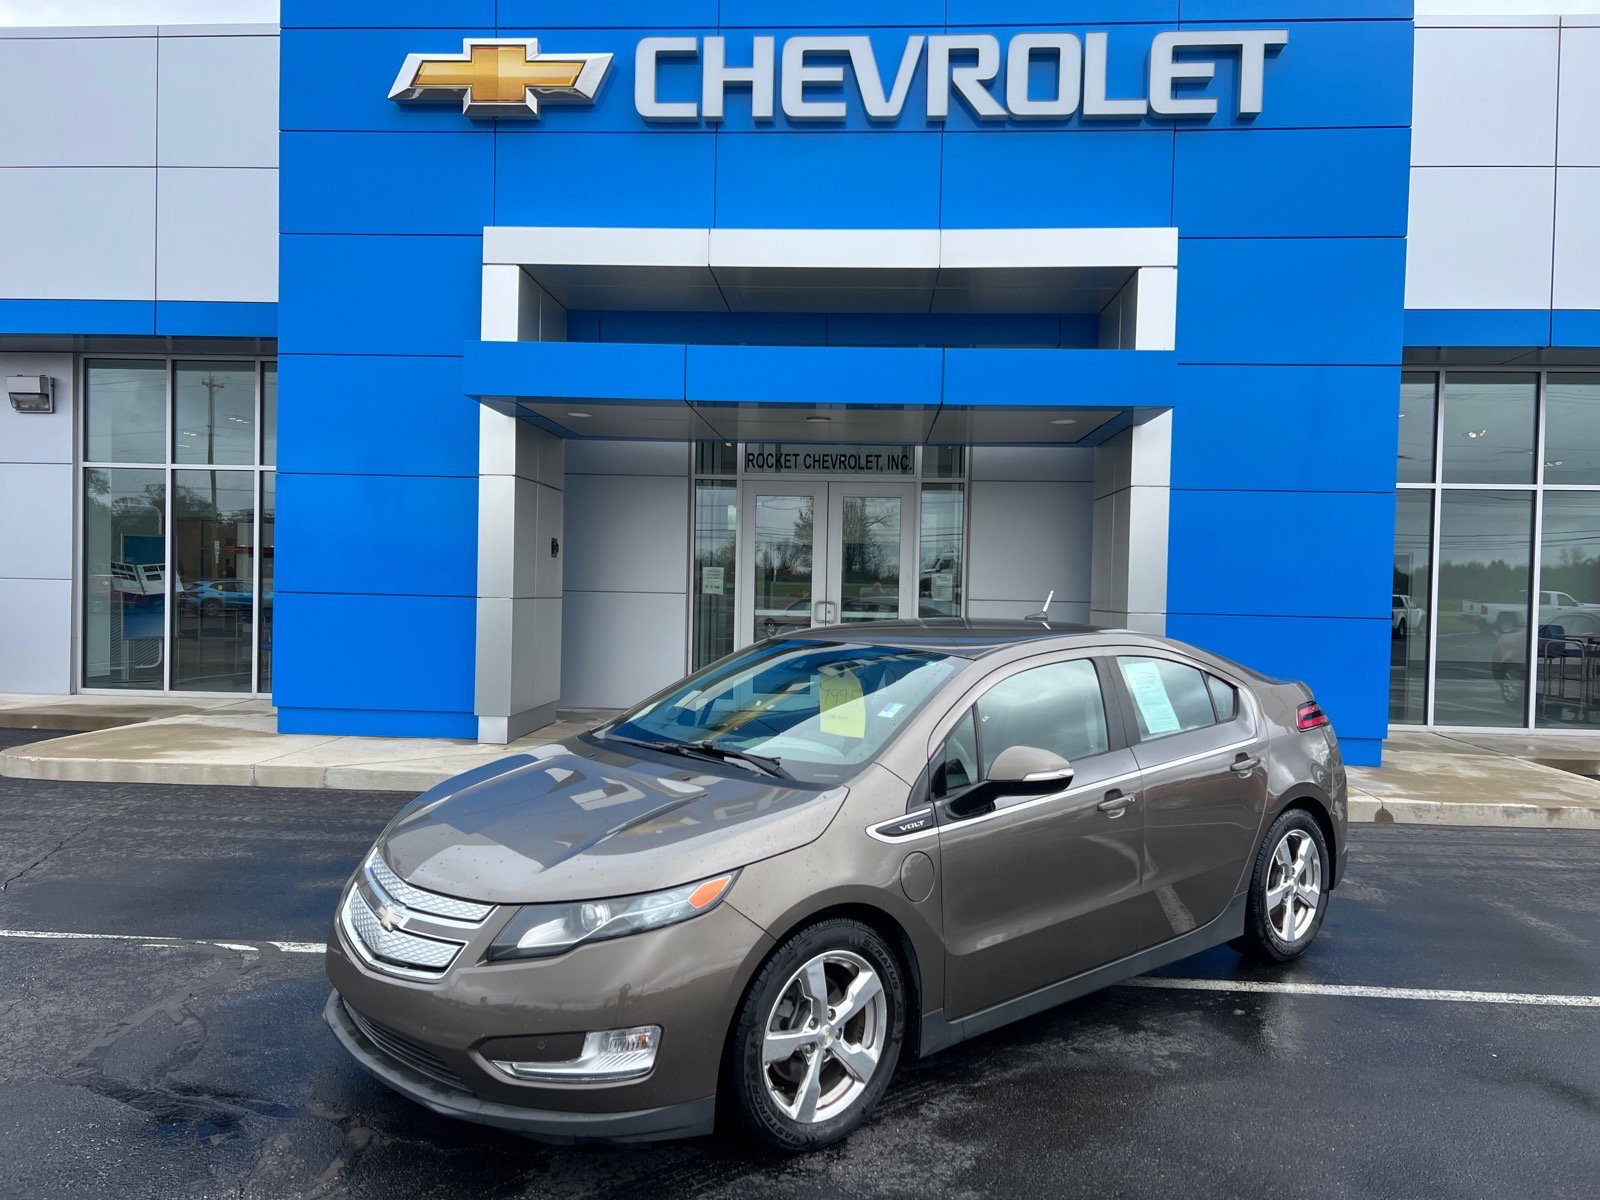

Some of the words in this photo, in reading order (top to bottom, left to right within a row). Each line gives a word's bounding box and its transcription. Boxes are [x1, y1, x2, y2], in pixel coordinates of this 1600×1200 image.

[634, 30, 1289, 122] CHEVROLET
[747, 452, 800, 469] ROCKET
[803, 453, 883, 472] CHEVROLET,
[887, 454, 912, 470] INC.
[900, 820, 925, 831] VOLT
